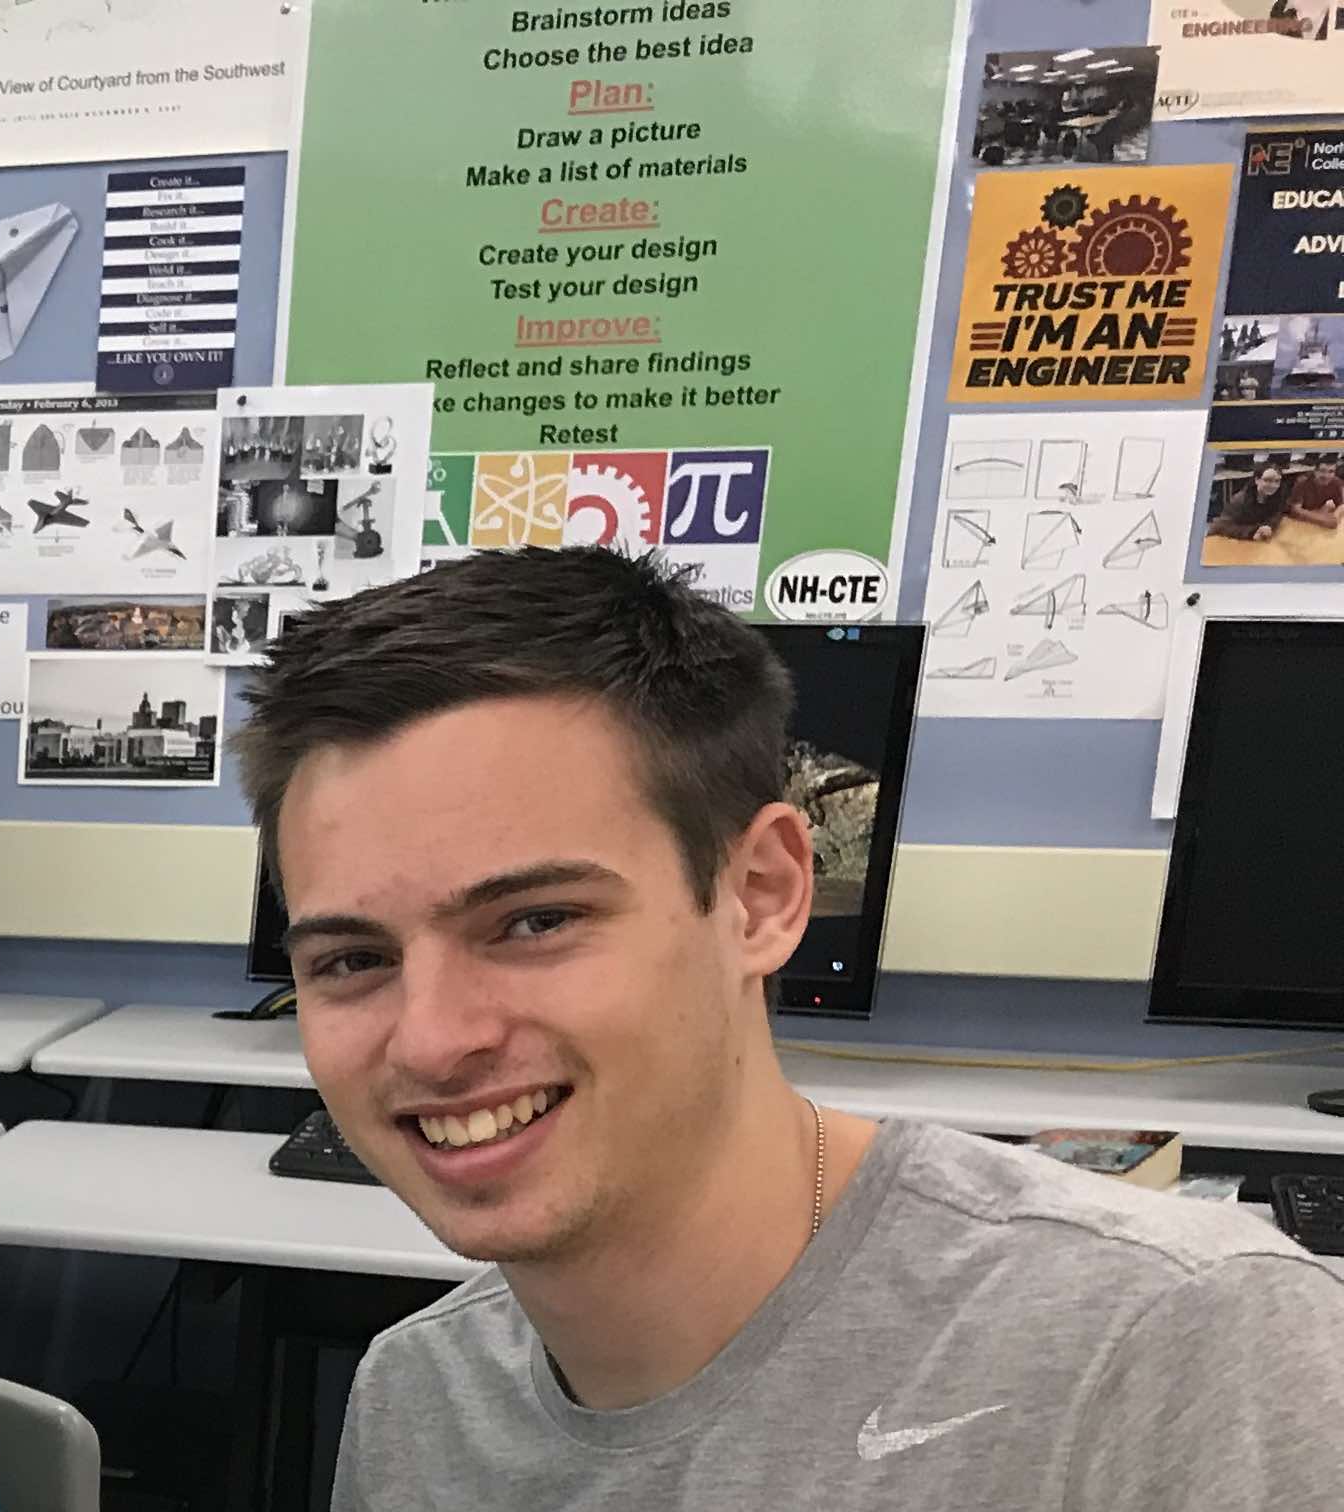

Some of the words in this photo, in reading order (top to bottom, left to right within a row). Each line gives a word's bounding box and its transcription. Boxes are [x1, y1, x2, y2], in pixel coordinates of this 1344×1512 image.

[512, 3, 653, 32] Brainstorm
[662, 0, 731, 22] ideas
[484, 47, 580, 70] Choose
[588, 42, 628, 64] the
[635, 36, 691, 60] best
[699, 34, 754, 56] idea
[0, 80, 34, 95] View
[38, 76, 54, 92] of
[57, 71, 132, 94] Courtyard
[135, 68, 171, 85] from
[174, 67, 199, 84] the
[202, 61, 286, 82] Southwest
[570, 79, 655, 110] Plan:
[518, 128, 582, 149] Draw
[589, 132, 603, 146] a
[611, 121, 701, 148] picture
[149, 176, 183, 189] Create
[466, 165, 531, 187] Make
[538, 166, 552, 184] a
[560, 159, 598, 183] list
[605, 157, 632, 180] of
[638, 153, 748, 179] materials
[142, 206, 188, 218] Research
[541, 198, 659, 227] Create:
[149, 235, 176, 247] Cook
[479, 244, 559, 266] Create
[566, 242, 624, 267] your
[631, 236, 717, 262] design
[491, 279, 541, 300] Test
[548, 277, 605, 302] your
[612, 273, 698, 298] design
[993, 281, 1125, 312] TRUST
[1126, 280, 1192, 309] ME
[517, 315, 661, 344] Improve:
[1001, 314, 1079, 353] I'M
[1082, 312, 1168, 350] AN
[146, 352, 171, 364] YOU
[173, 350, 208, 363] OWN
[426, 357, 509, 379] Reflect
[517, 356, 562, 378] and
[569, 353, 640, 377] share
[648, 351, 751, 377] findings
[965, 355, 1191, 388] ENGINEER
[33, 398, 79, 411] February
[81, 397, 92, 409] 6,
[94, 398, 120, 409] 2013
[463, 391, 566, 416] changes
[574, 393, 598, 410] to
[606, 388, 673, 409] make
[681, 386, 697, 406] it
[705, 384, 781, 406] better
[539, 424, 618, 445] Retest
[778, 576, 881, 604] NH-CTE
